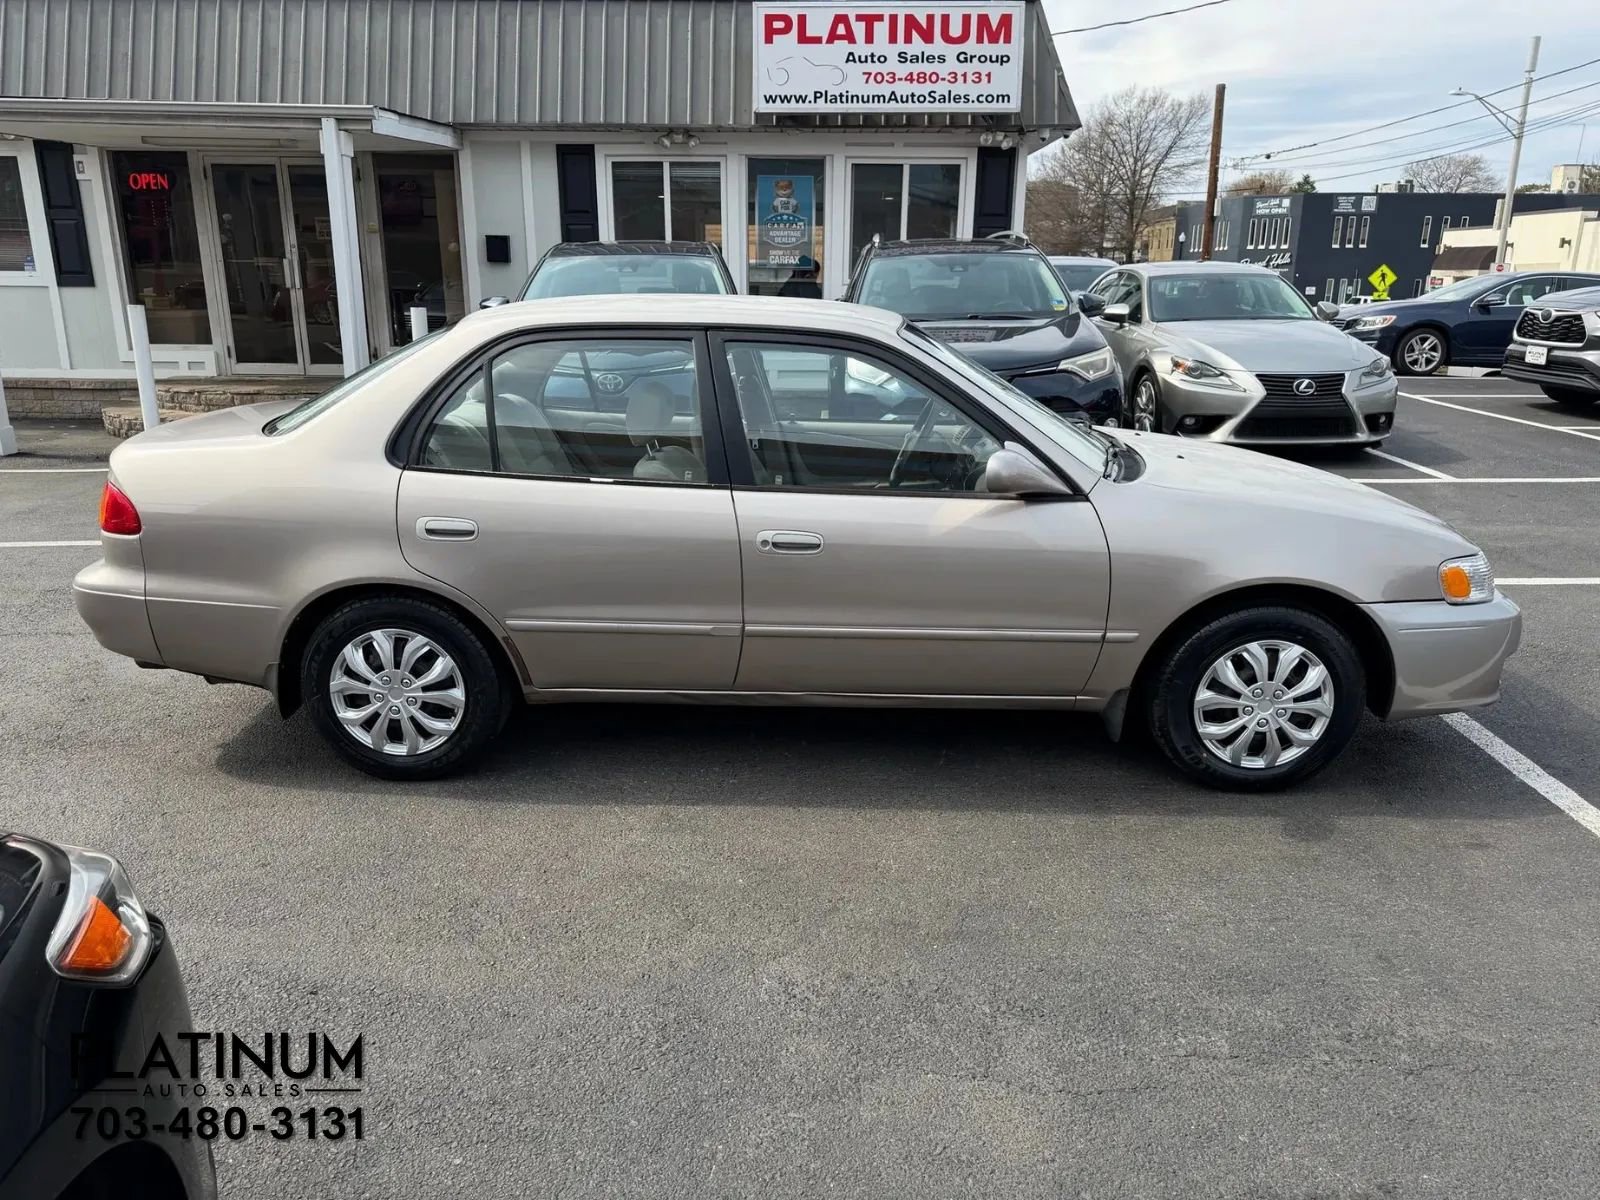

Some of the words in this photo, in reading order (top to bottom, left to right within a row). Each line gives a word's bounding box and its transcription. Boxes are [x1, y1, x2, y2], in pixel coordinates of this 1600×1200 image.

[764, 13, 1013, 45] PLATINUM
[845, 51, 888, 64] Auto
[897, 51, 946, 64] Sales
[955, 51, 1011, 66] Group
[862, 71, 992, 84] 703-480-3131
[763, 90, 1011, 105] www.PlatinumAutoSales.com
[130, 173, 169, 190] OPEN
[769, 256, 800, 264] CARFAX
